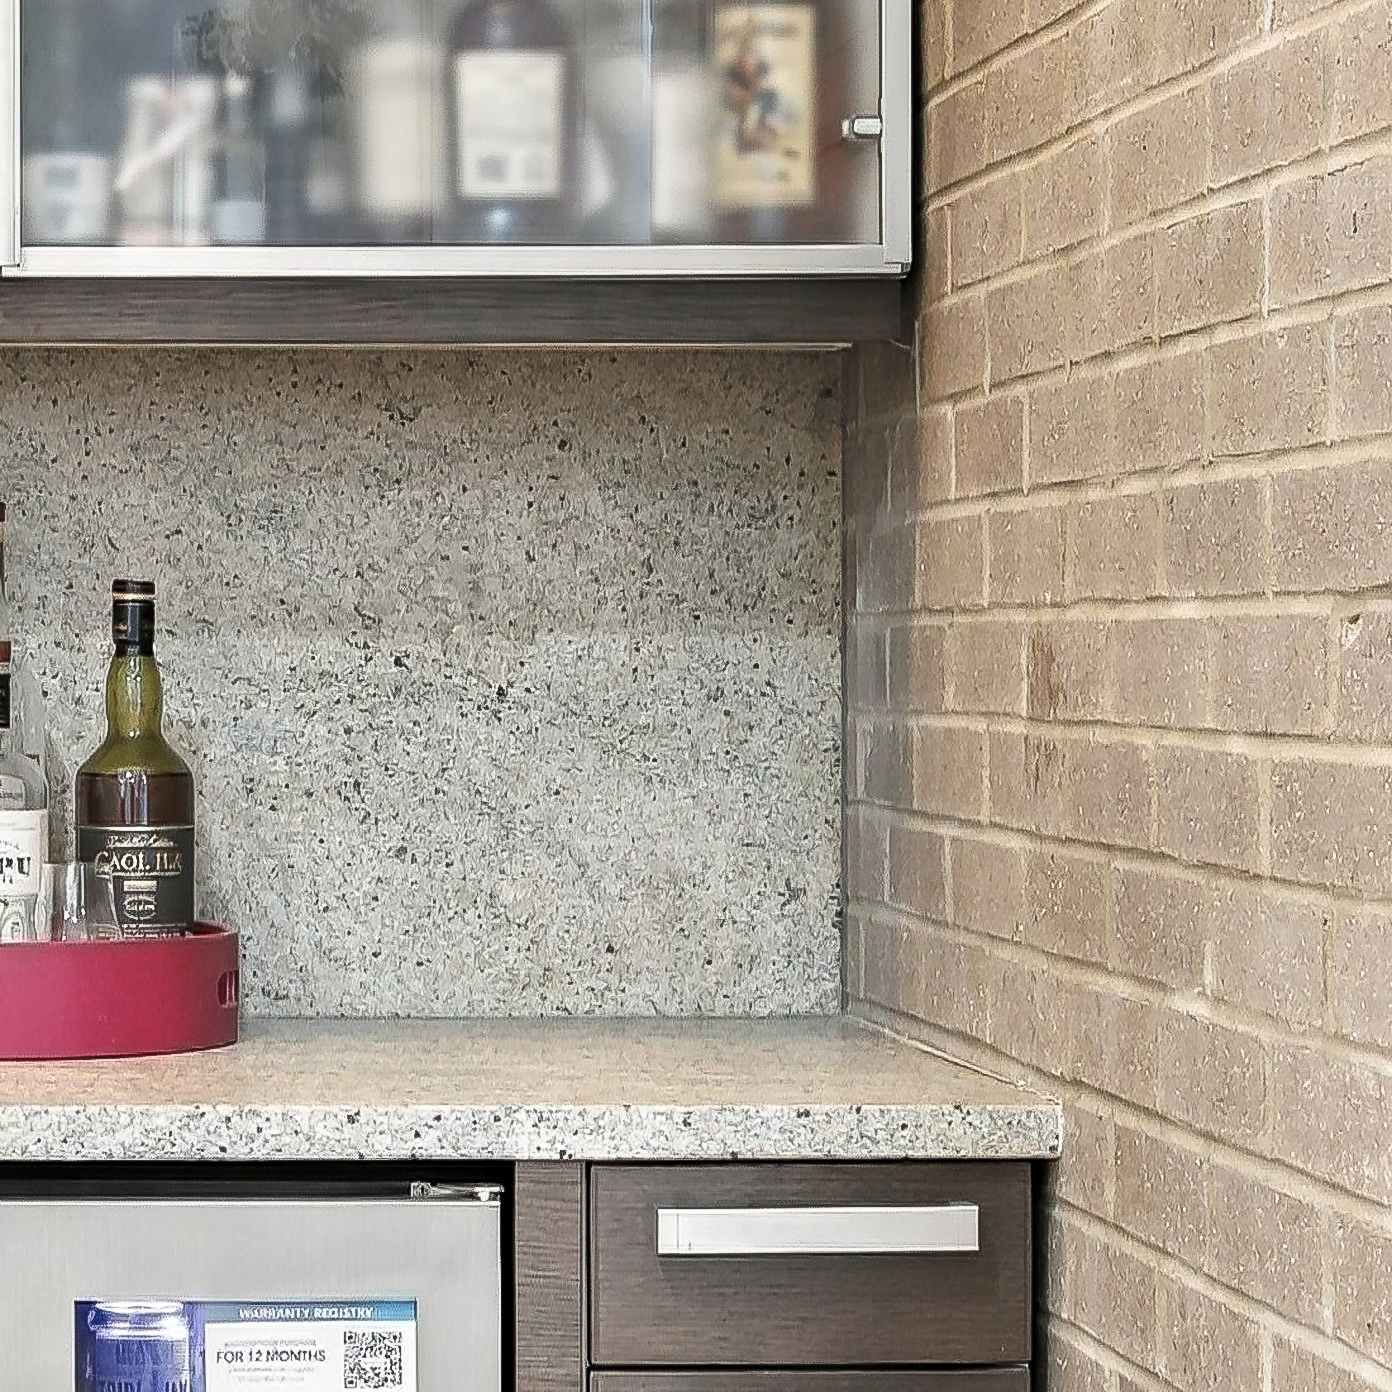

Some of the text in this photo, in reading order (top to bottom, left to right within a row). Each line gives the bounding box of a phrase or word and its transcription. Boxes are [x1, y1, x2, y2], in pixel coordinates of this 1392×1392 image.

[239, 1307, 375, 1319] WARRANTY REGISTRY
[216, 1348, 327, 1364] FOR 12 MONTHS
